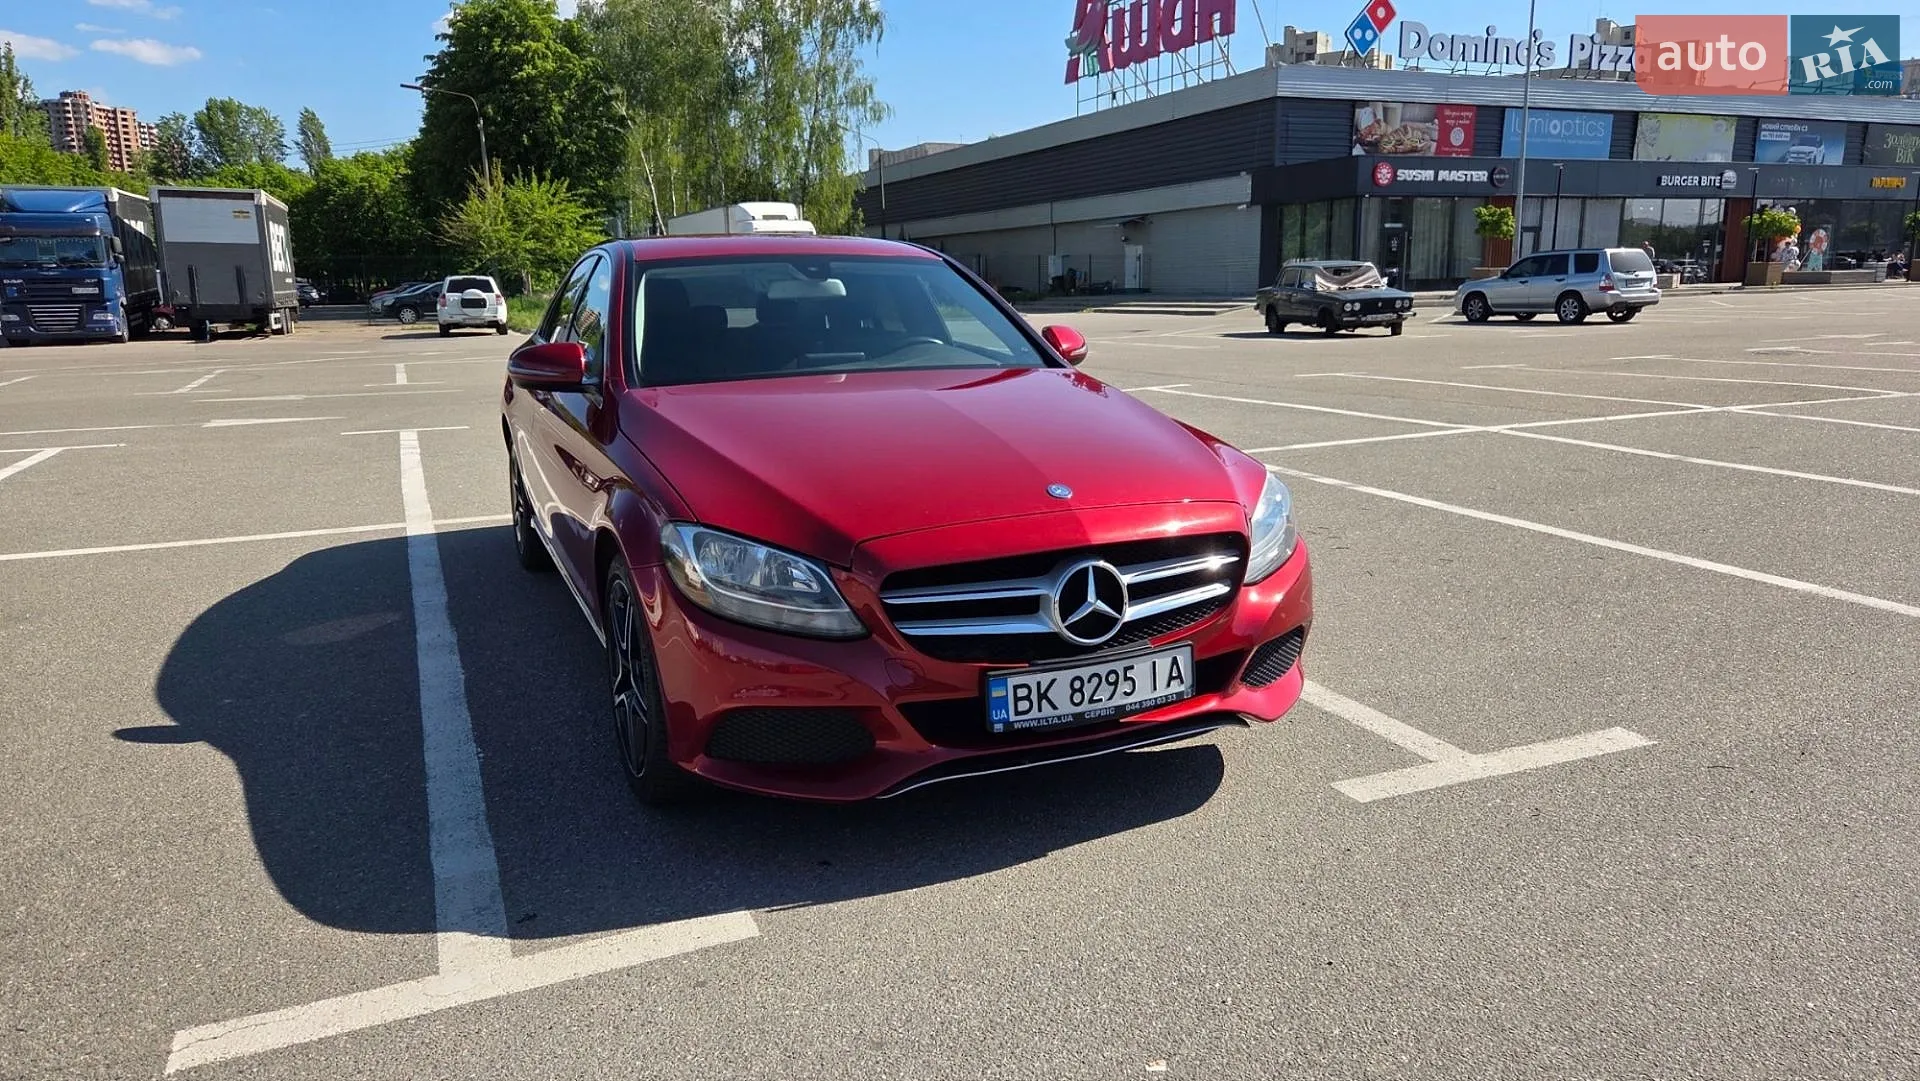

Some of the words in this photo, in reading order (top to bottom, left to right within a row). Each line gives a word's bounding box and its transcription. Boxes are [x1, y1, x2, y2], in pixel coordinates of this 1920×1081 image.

[1398, 21, 1556, 67] Domino's
[1396, 169, 1435, 182] SUSHI
[1437, 169, 1489, 183] MASTER
[1661, 175, 1699, 187] BURGER
[1700, 175, 1721, 187] BITE
[1012, 678, 1058, 717] BK
[1069, 664, 1137, 707] 8295
[992, 709, 1008, 720] UA
[1013, 714, 1074, 730] WWW.ILTA.UA
